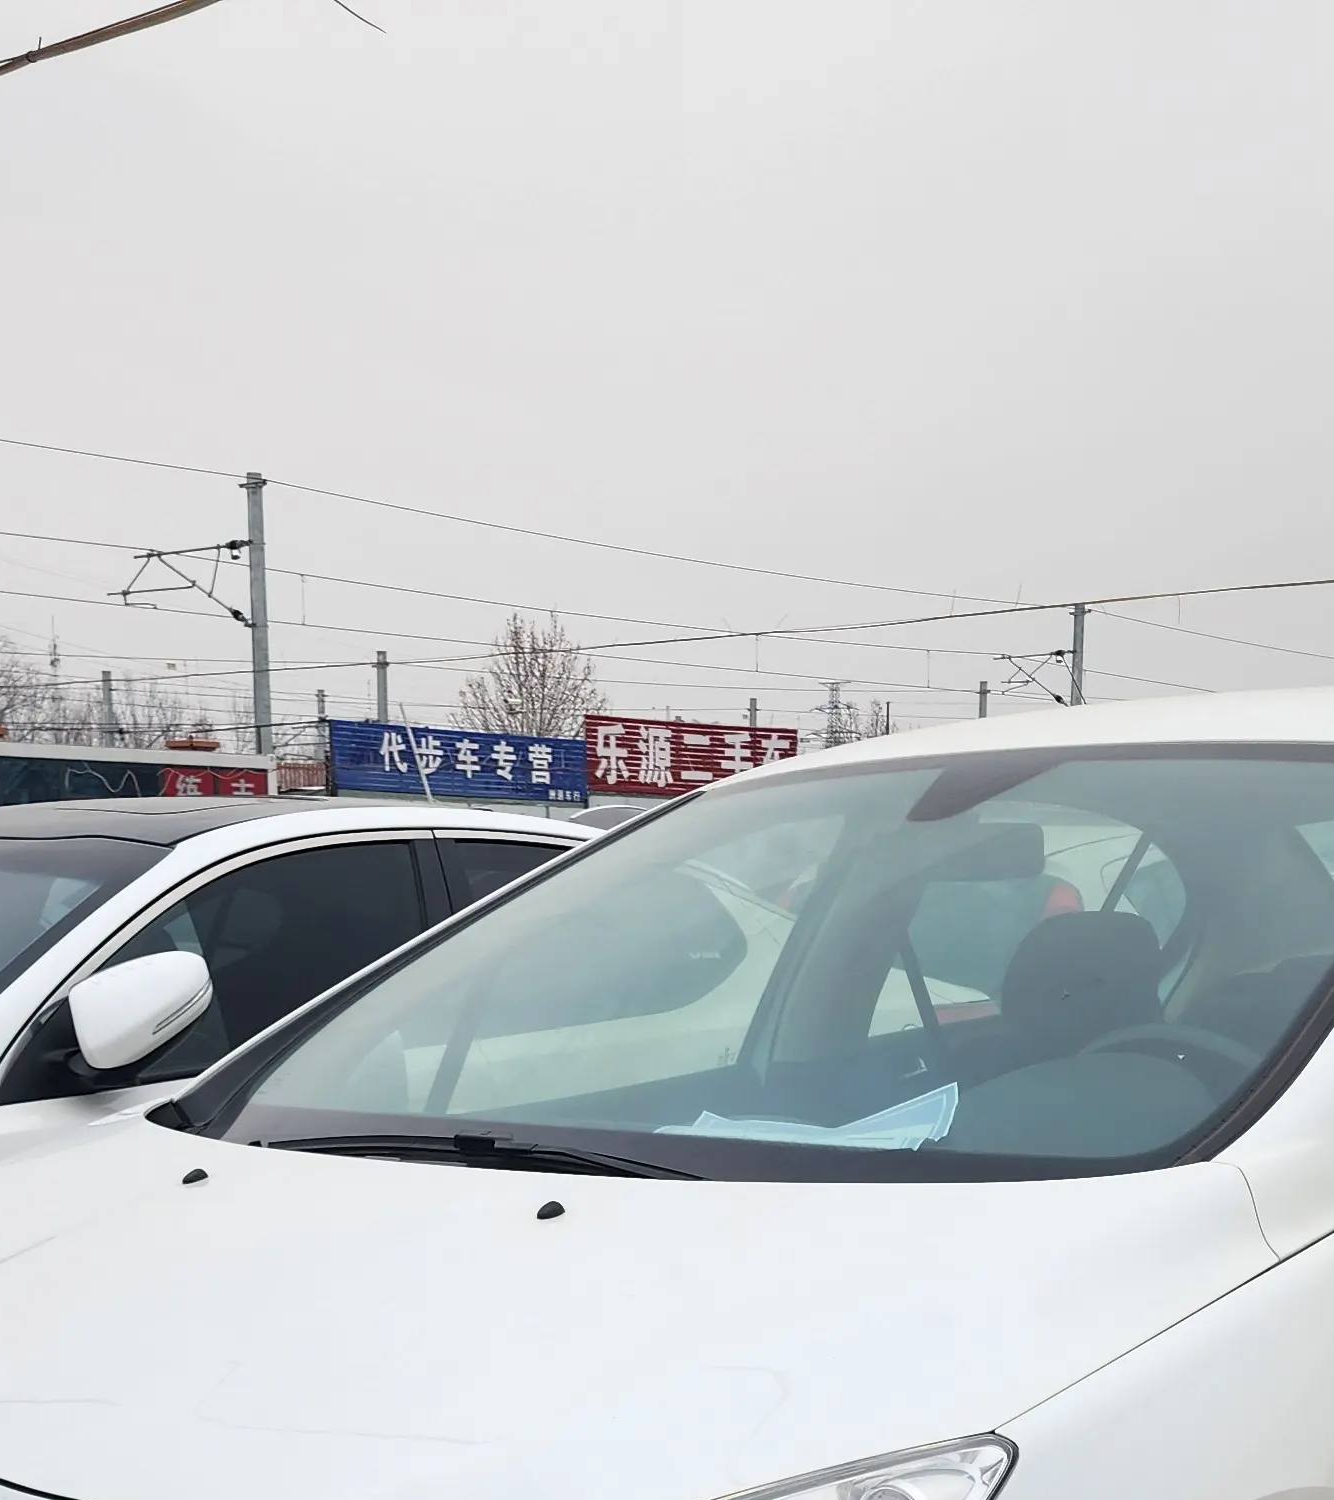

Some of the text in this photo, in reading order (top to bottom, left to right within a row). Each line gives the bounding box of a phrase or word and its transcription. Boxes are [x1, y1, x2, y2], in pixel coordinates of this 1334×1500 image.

[380, 732, 553, 785] 代步车专营
